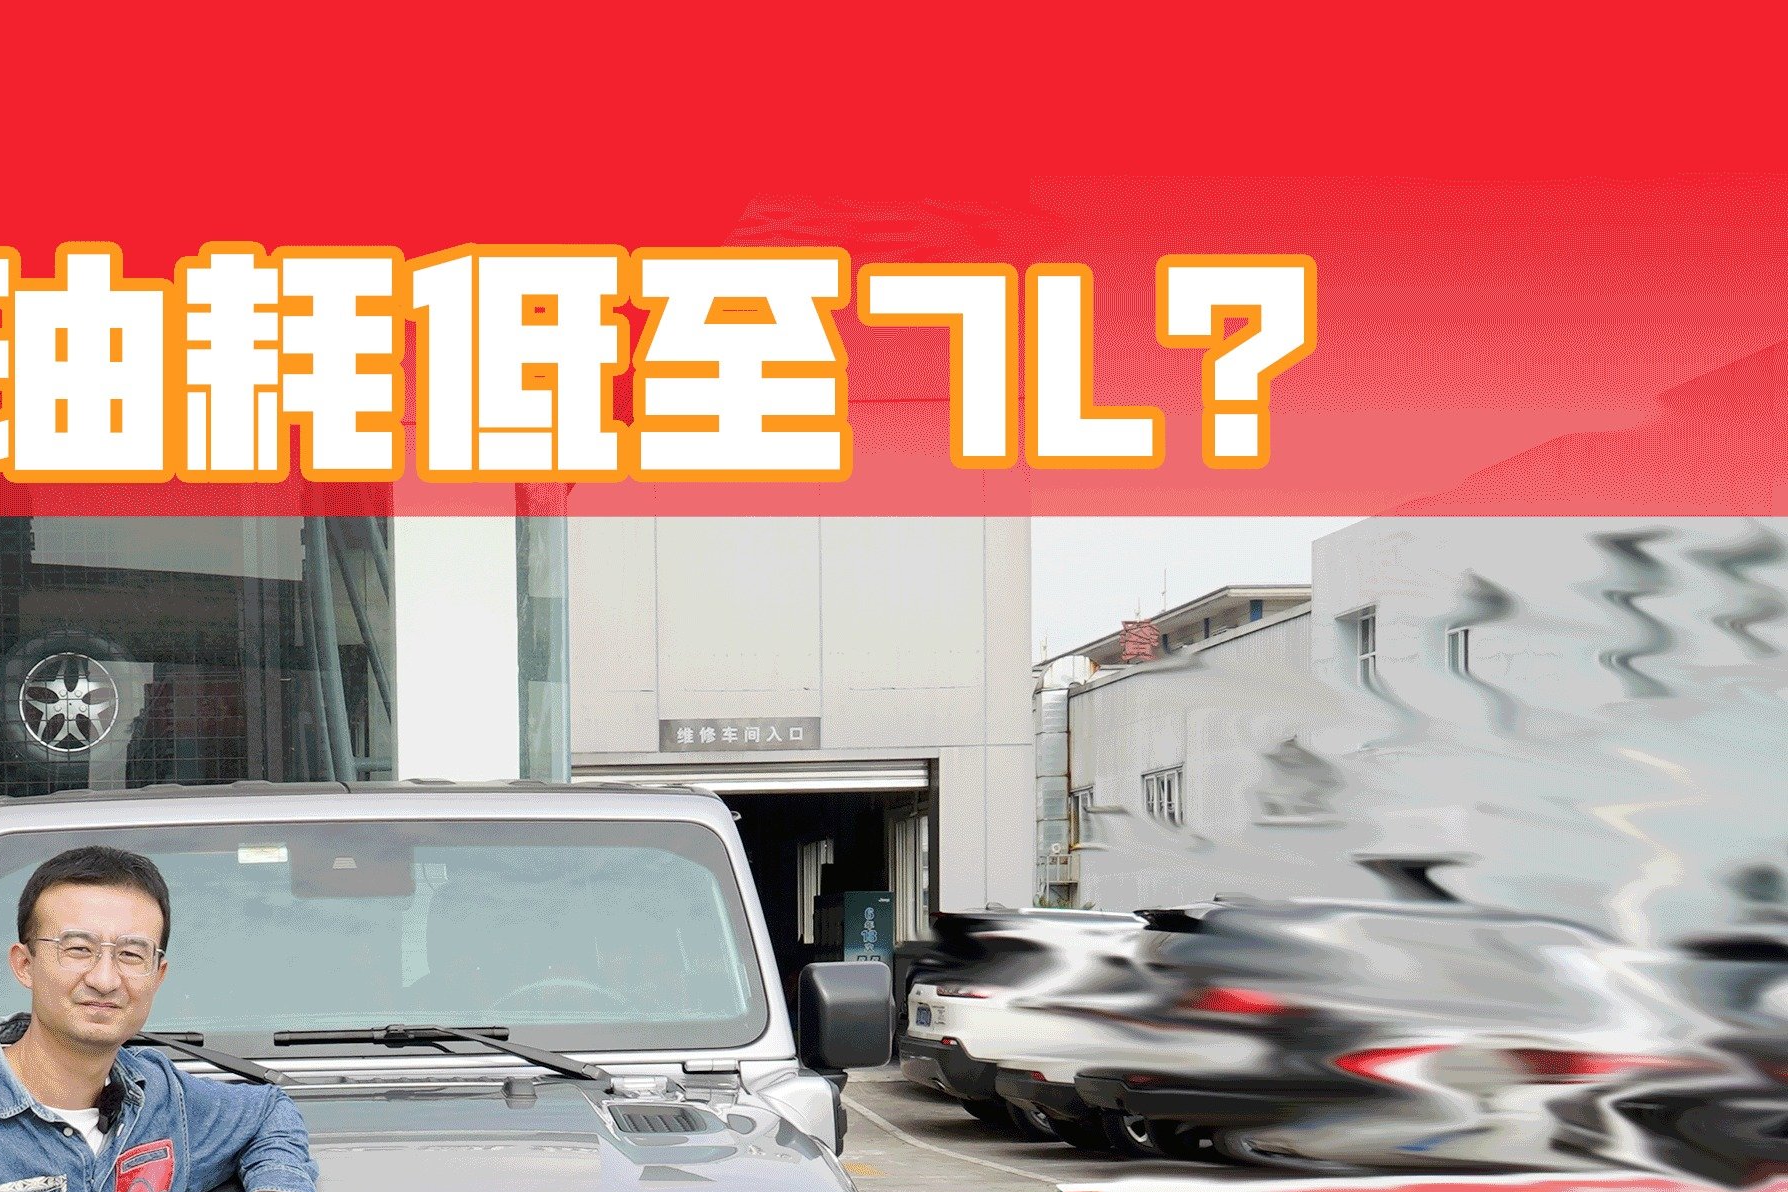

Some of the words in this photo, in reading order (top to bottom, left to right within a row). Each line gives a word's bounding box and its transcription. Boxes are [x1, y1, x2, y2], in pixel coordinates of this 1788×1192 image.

[676, 725, 805, 744] 维修车间入口
